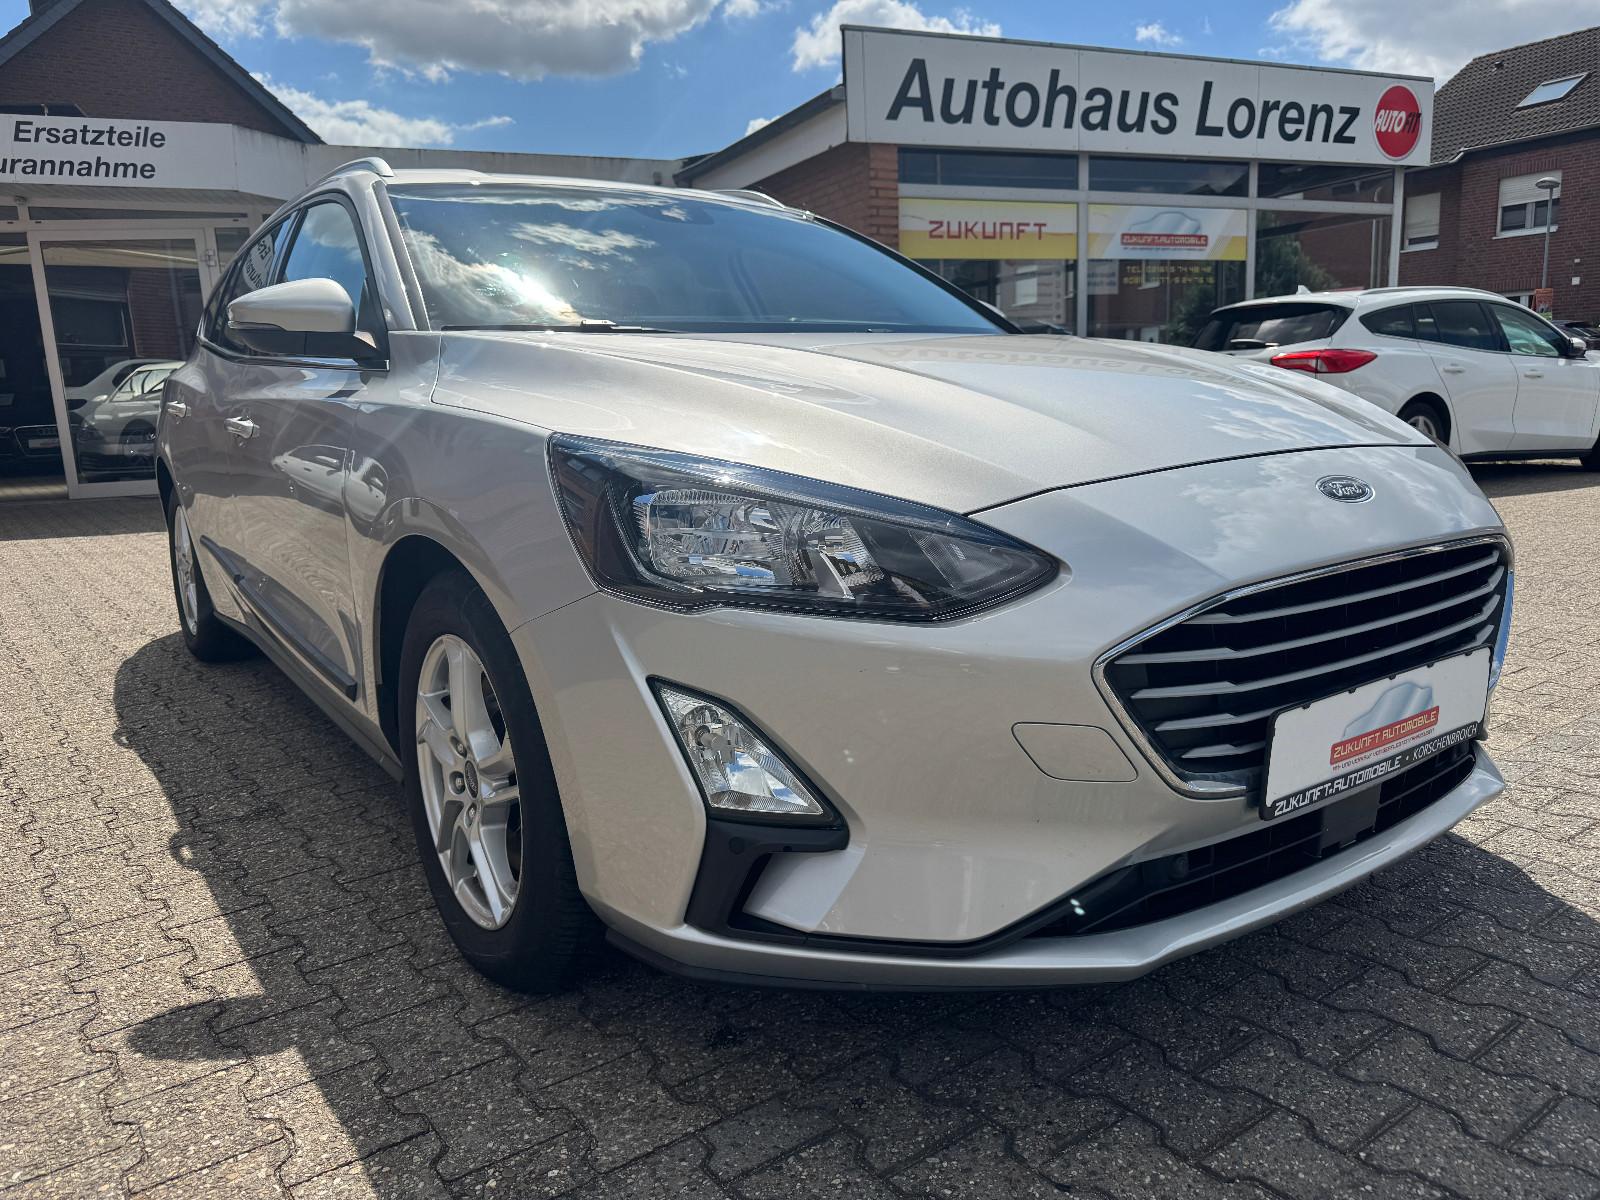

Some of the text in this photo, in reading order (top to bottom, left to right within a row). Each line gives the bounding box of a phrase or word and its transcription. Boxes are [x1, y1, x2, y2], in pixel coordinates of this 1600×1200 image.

[885, 58, 1360, 145] Autohaus Lorenz
[13, 120, 166, 148] Ersatzteile
[928, 210, 1047, 240] ZUKUNFT
[1329, 481, 1362, 496] Ford
[1412, 724, 1478, 761] KORSCHENBROICH
